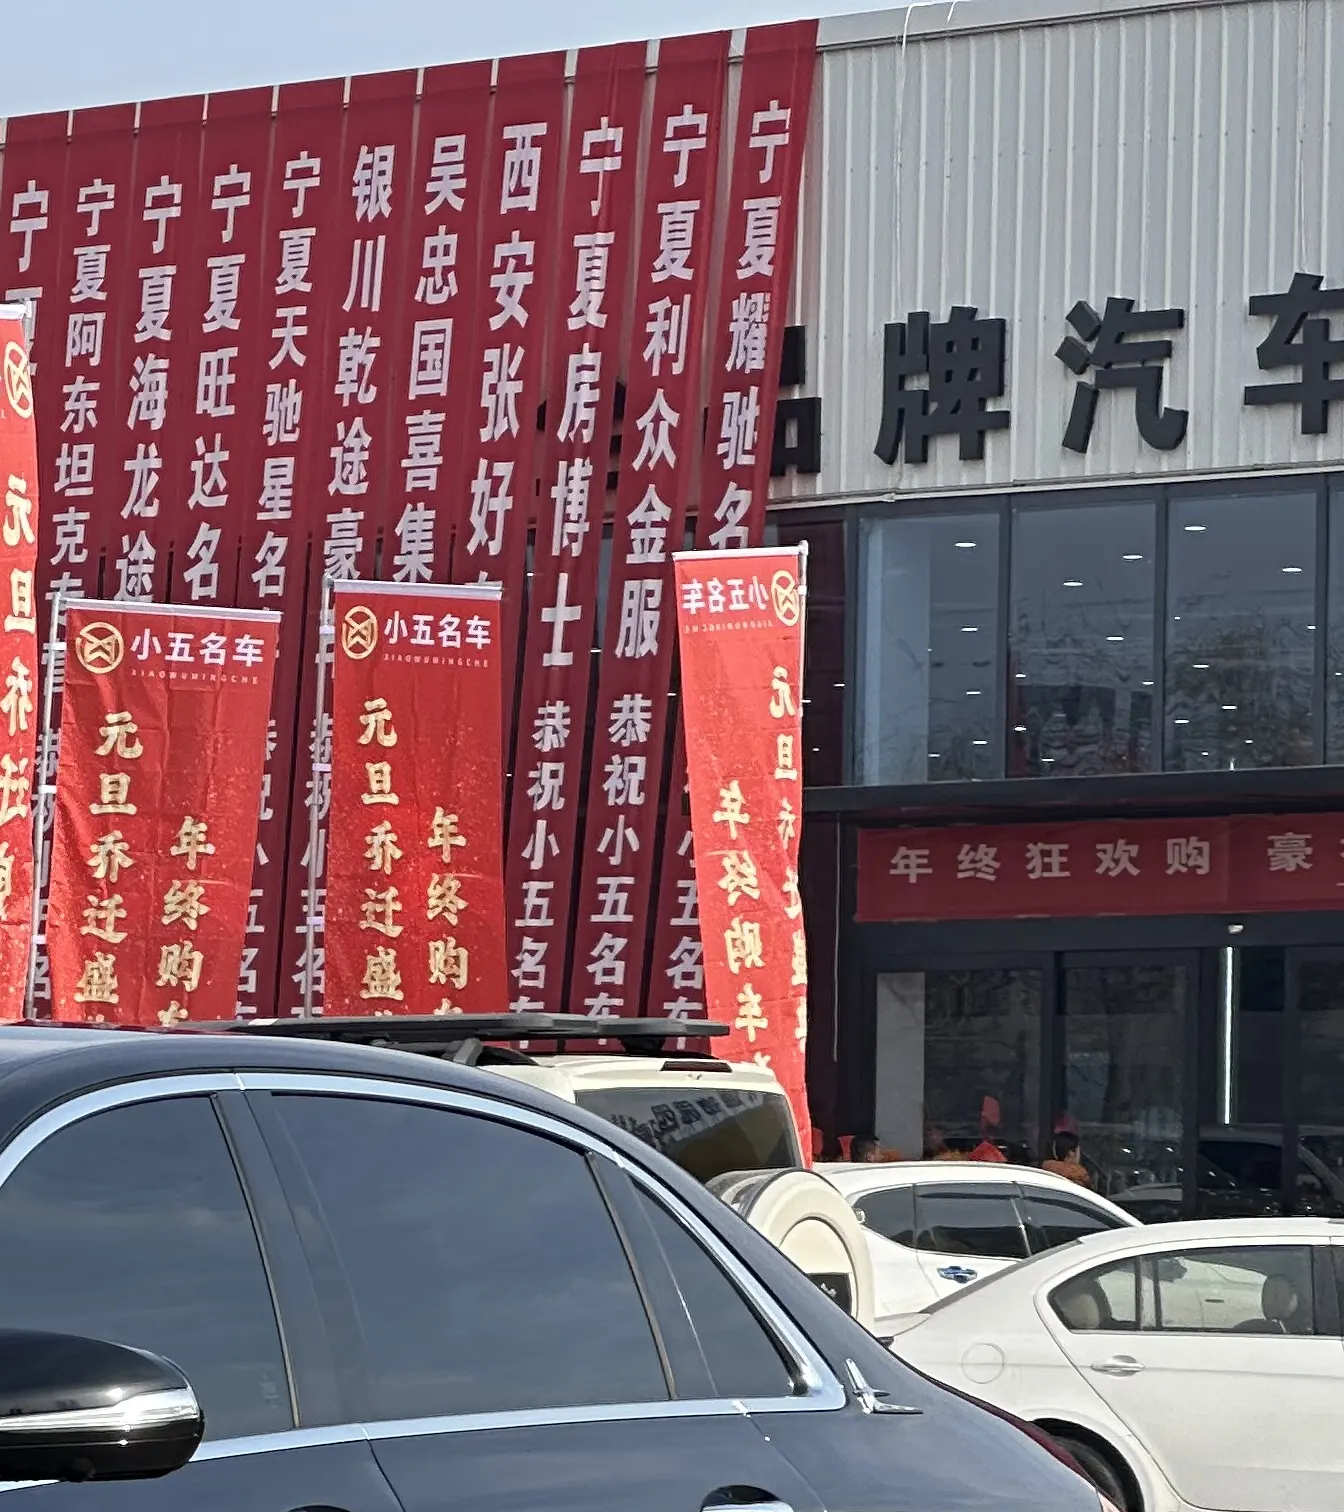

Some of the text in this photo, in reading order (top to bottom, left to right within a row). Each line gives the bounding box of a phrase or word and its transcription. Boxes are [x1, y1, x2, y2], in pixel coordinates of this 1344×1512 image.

[252, 151, 320, 606] 宁夏天驰星名
[467, 122, 547, 575] 西安张好
[541, 117, 623, 667] 宁夏房博士
[616, 104, 708, 659] 宁夏利众金服
[130, 628, 265, 666] 小五名车
[384, 611, 491, 650] 小五名车
[74, 710, 143, 1010] 元旦乔迁盛
[356, 697, 404, 1006] 元旦乔迁盛
[890, 835, 1211, 884] 年终狂欢购
